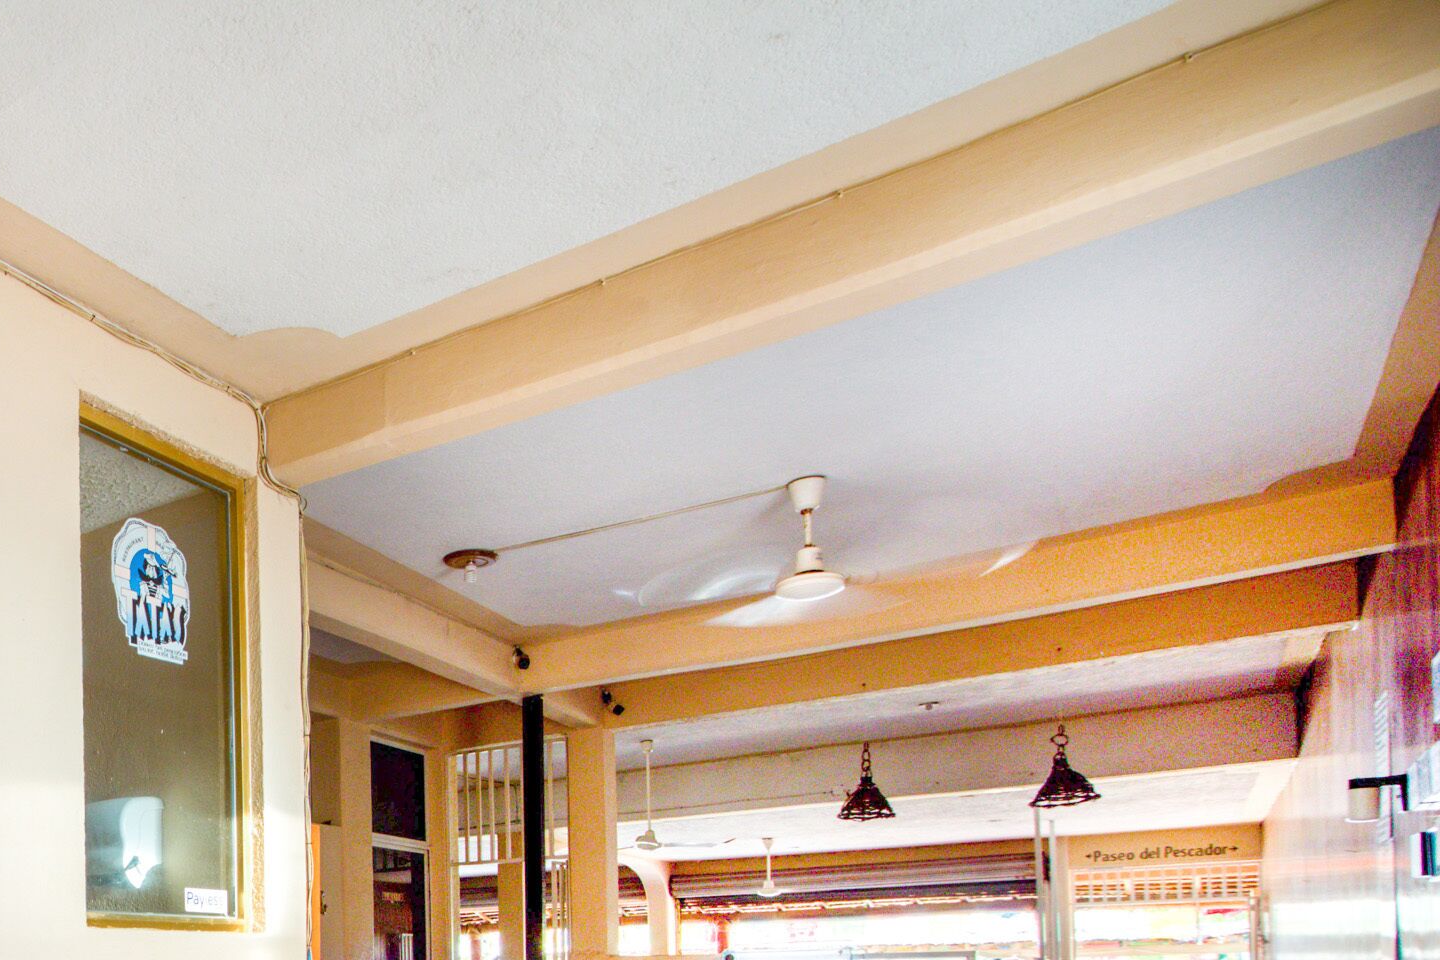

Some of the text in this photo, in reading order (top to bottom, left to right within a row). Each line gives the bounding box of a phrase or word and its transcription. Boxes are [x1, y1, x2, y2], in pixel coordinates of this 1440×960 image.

[1093, 844, 1228, 862] Paseo del Pescador
